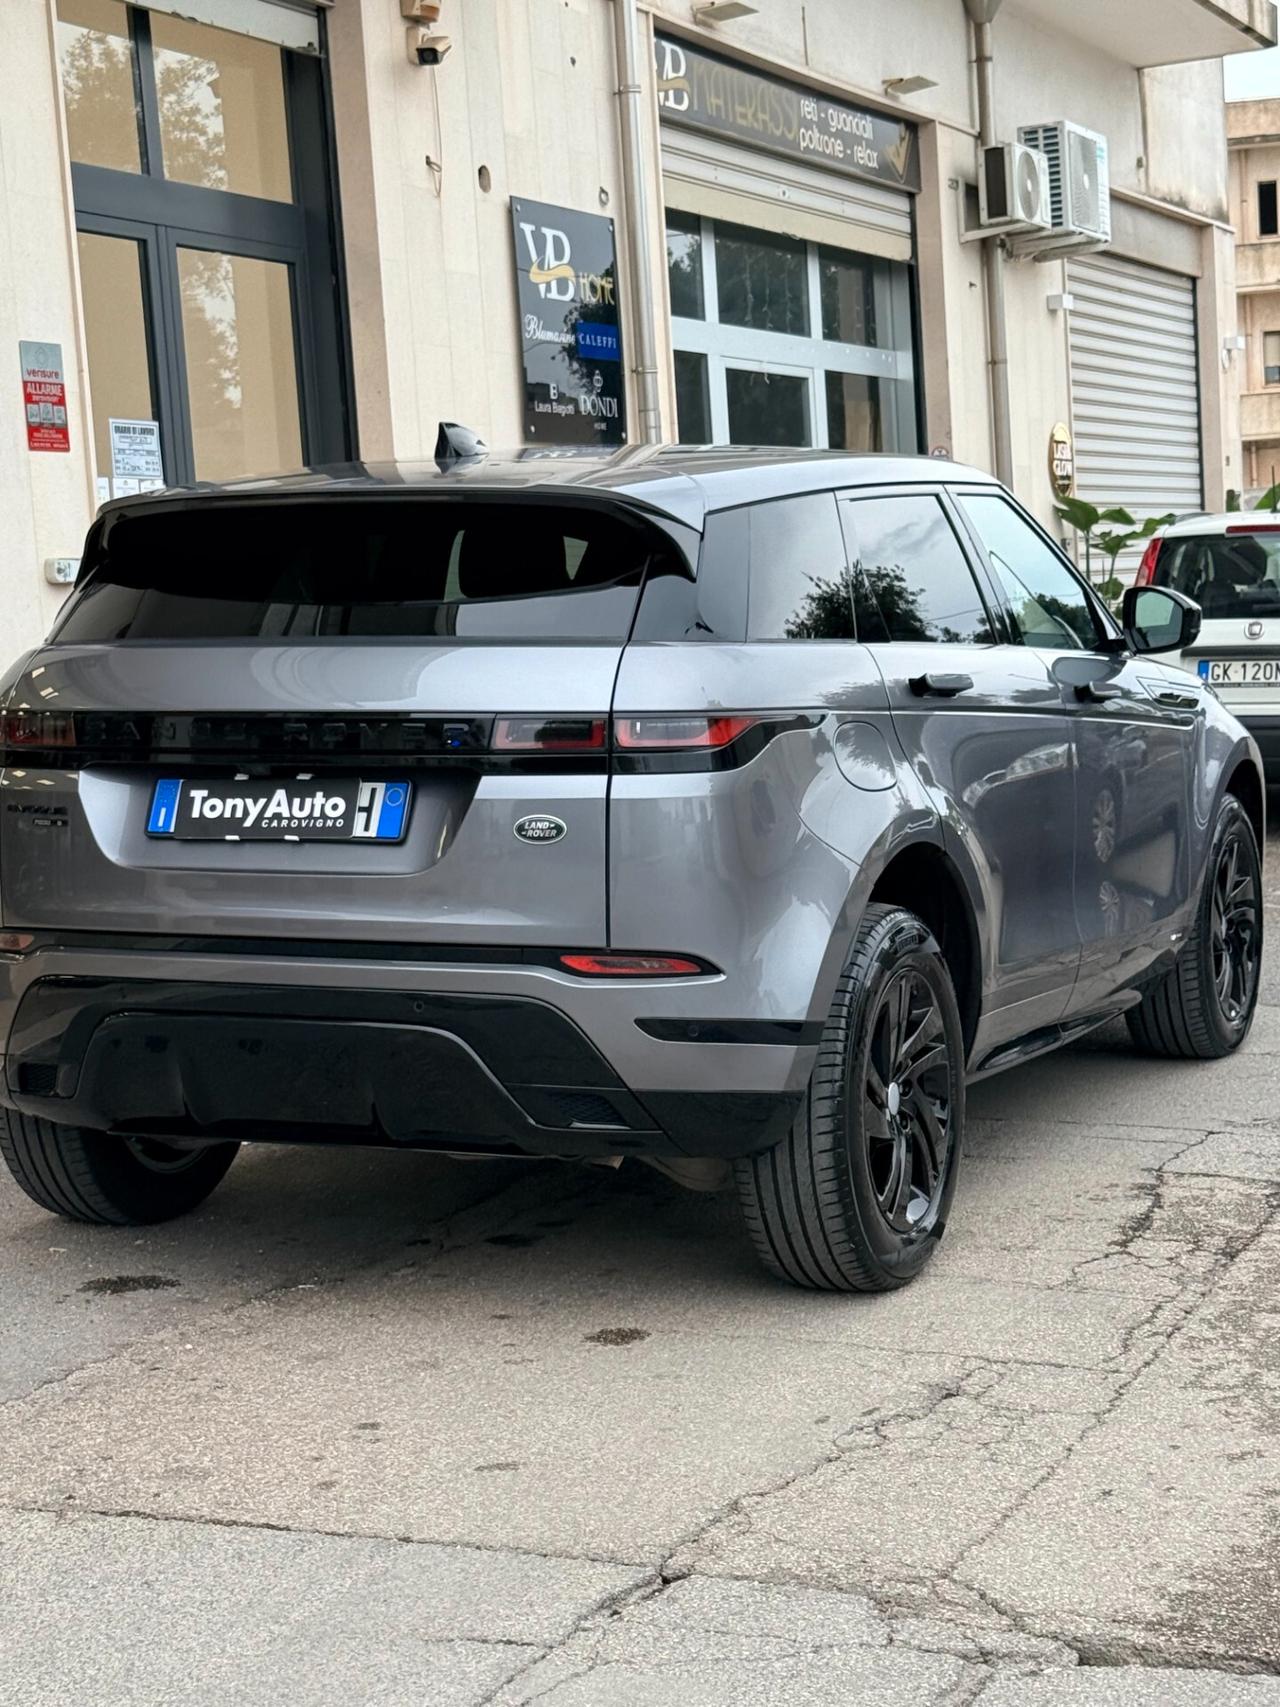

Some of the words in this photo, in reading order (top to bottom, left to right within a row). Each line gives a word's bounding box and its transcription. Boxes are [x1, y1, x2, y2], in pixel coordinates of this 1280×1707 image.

[801, 97, 818, 122] reti
[828, 108, 873, 140] guanciali
[799, 125, 844, 158] poltrone
[854, 140, 879, 169] relax
[519, 222, 575, 302] VB
[579, 271, 615, 305] HOME
[579, 332, 617, 349] CALEFFI
[26, 382, 63, 397] ALLARME
[550, 383, 558, 400] B
[579, 395, 618, 418] DONDI
[1211, 663, 1232, 681] GK
[189, 788, 346, 828] TonyAuto
[261, 818, 344, 828] CAROVIGNO
